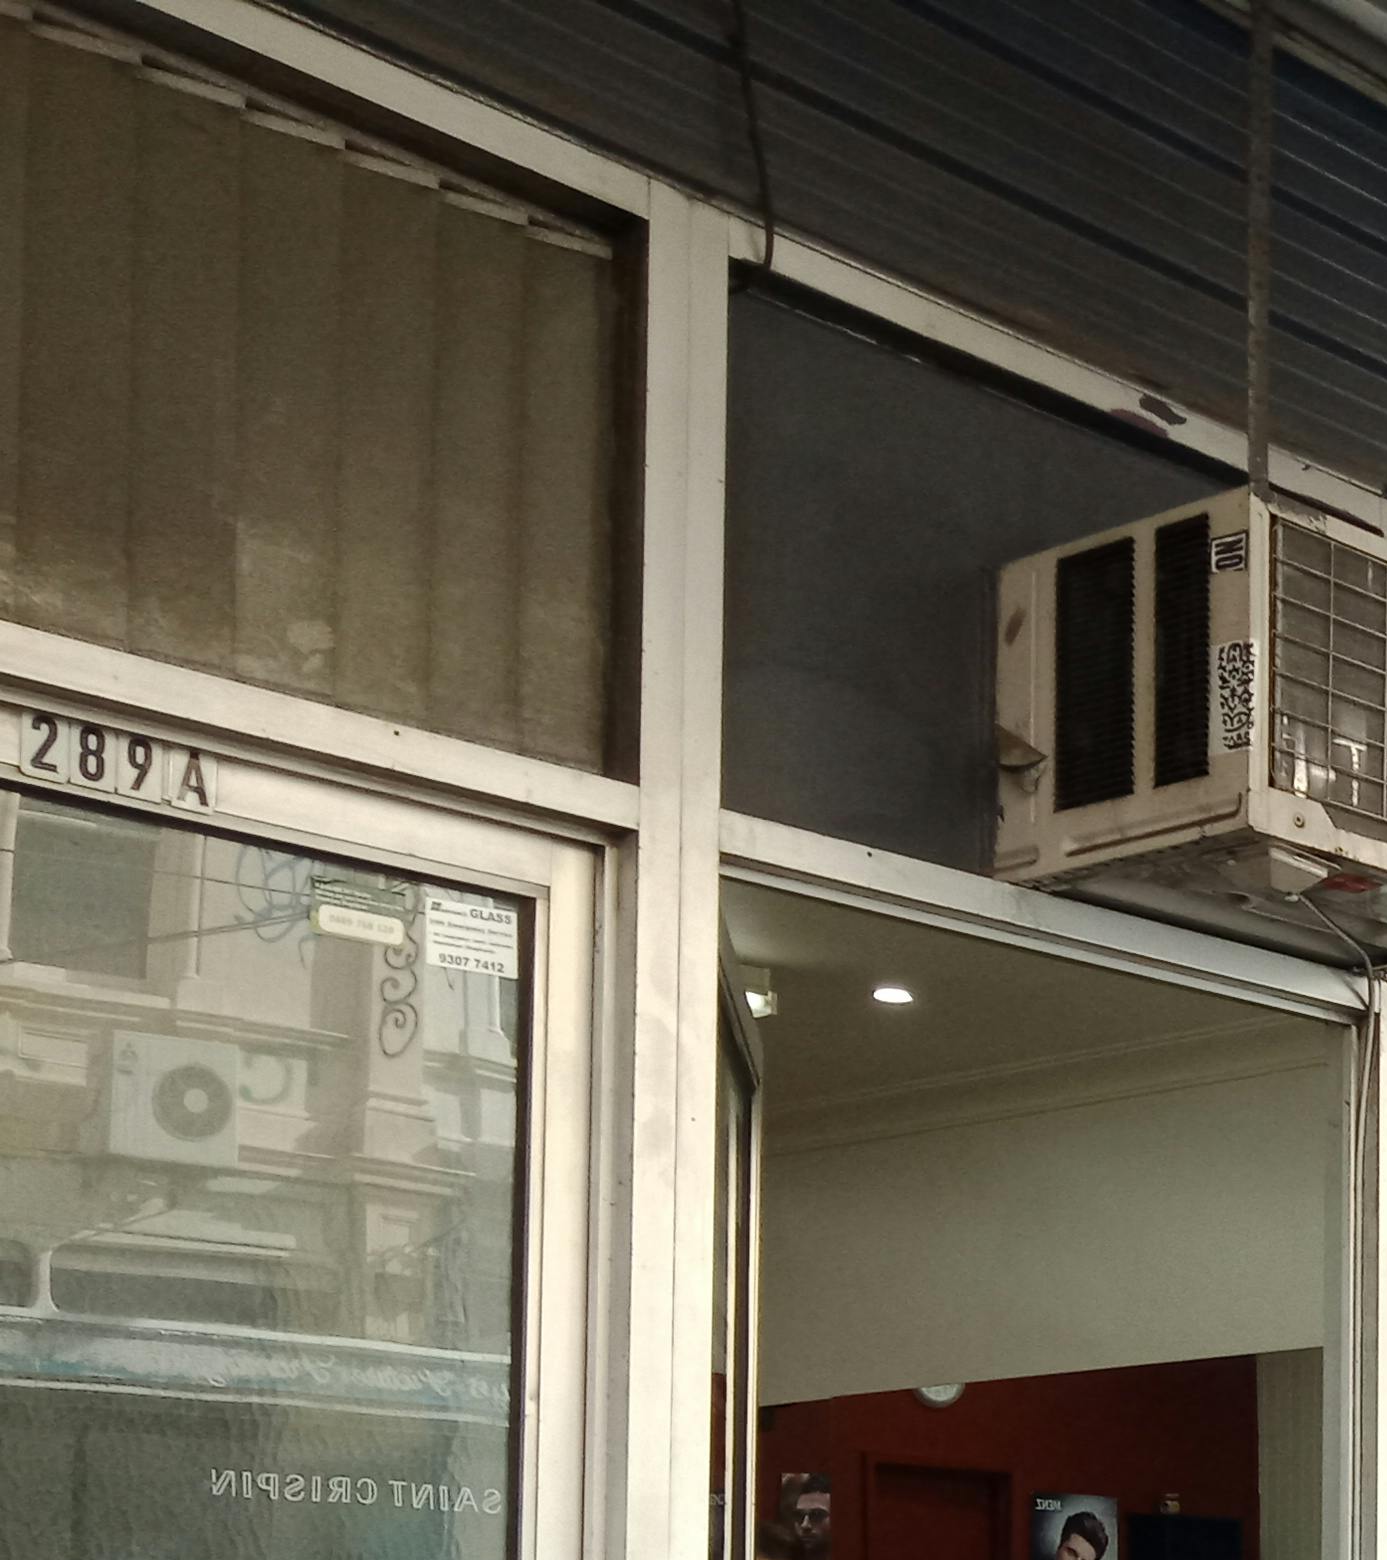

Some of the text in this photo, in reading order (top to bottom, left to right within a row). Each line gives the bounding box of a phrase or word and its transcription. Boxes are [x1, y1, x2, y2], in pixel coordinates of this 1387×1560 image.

[30, 715, 210, 808] 289A
[470, 908, 512, 925] GLASS
[438, 952, 505, 974] 9307 7412
